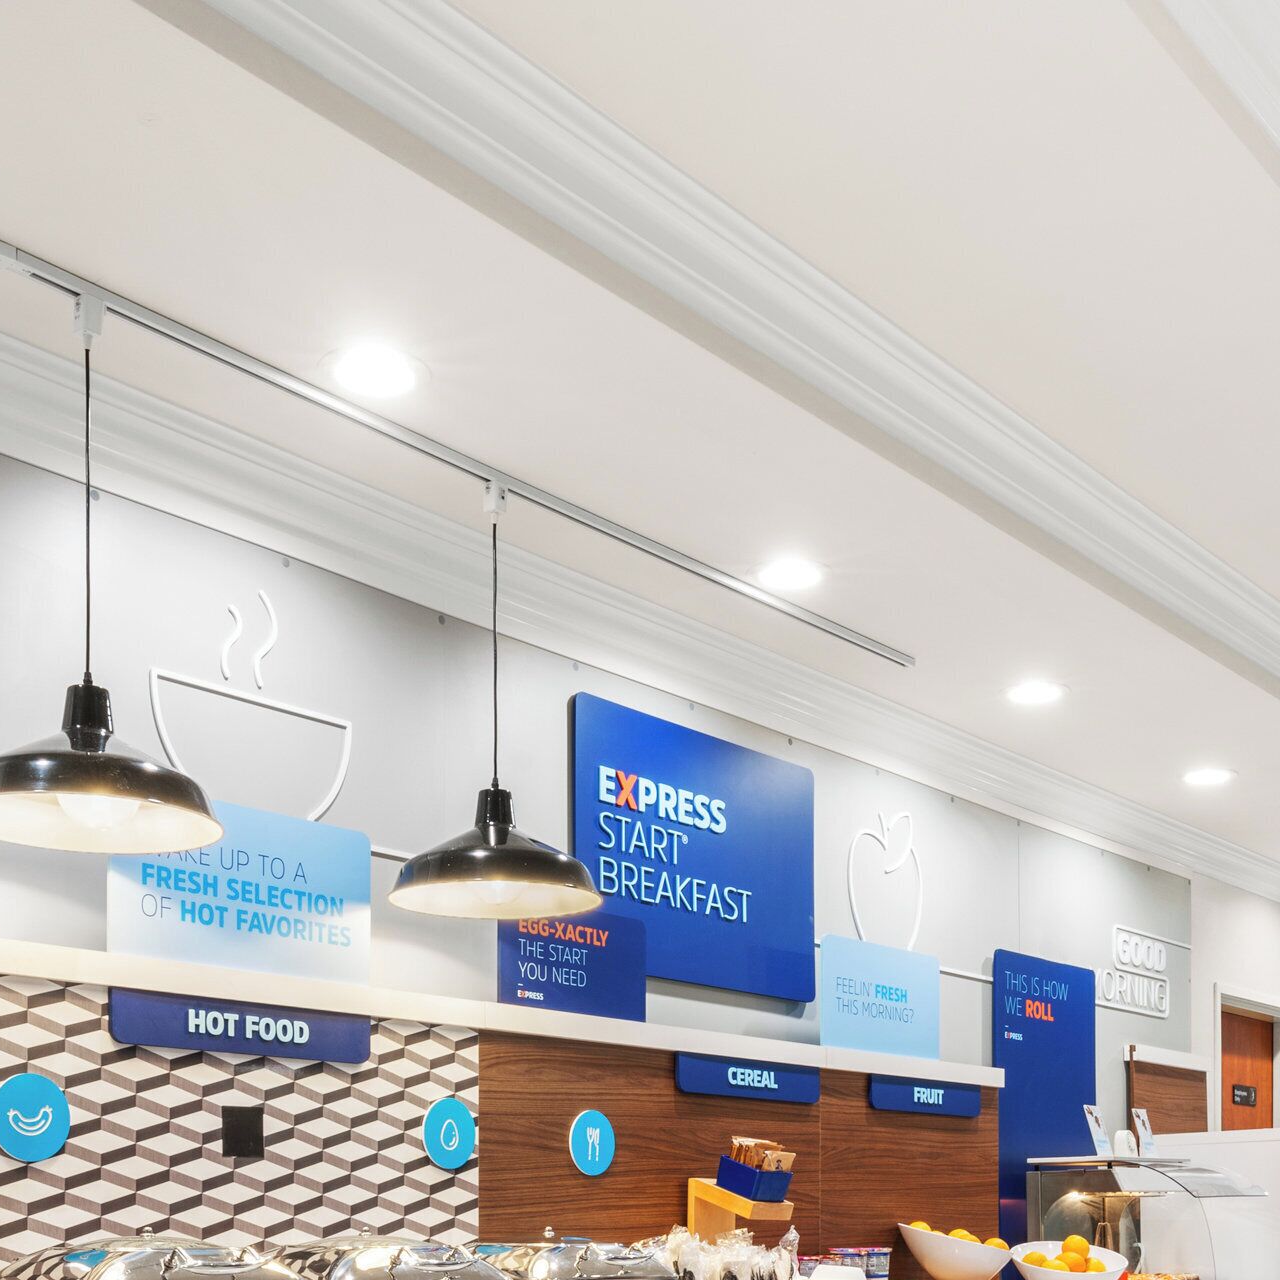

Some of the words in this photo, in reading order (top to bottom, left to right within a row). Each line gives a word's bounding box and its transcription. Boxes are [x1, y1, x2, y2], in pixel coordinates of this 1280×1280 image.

[598, 765, 727, 834] EXPRESS
[220, 847, 250, 872] UP
[258, 853, 286, 880] TO
[293, 861, 308, 885] A
[141, 862, 219, 898] FRESH
[226, 877, 344, 917] SELECTION
[599, 856, 752, 923] BREAKFAST
[141, 893, 173, 918] OF
[181, 899, 229, 928] HOT
[236, 909, 352, 948] FAVORITES
[518, 917, 609, 947] EGG-XACTLY
[518, 938, 545, 960] THE
[548, 944, 588, 966] START
[1118, 933, 1167, 973] GOOD
[518, 961, 548, 982] YOU
[552, 967, 587, 987] NEED
[1005, 971, 1028, 994] THIS
[1031, 977, 1040, 997] IS
[1043, 980, 1069, 1001] HOW
[517, 990, 544, 1001] EXPRESS
[875, 983, 908, 1003] FRESH
[836, 997, 859, 1016] THIS
[861, 1002, 915, 1023] MORNING?
[1005, 995, 1023, 1017] WE
[1025, 999, 1055, 1022] ROLL
[188, 1009, 239, 1037] HOT
[245, 1015, 310, 1045] FOOD
[1005, 1031, 1023, 1041] EXPRESS
[727, 1066, 778, 1089] CEREAL
[913, 1086, 945, 1105] FRUIT
